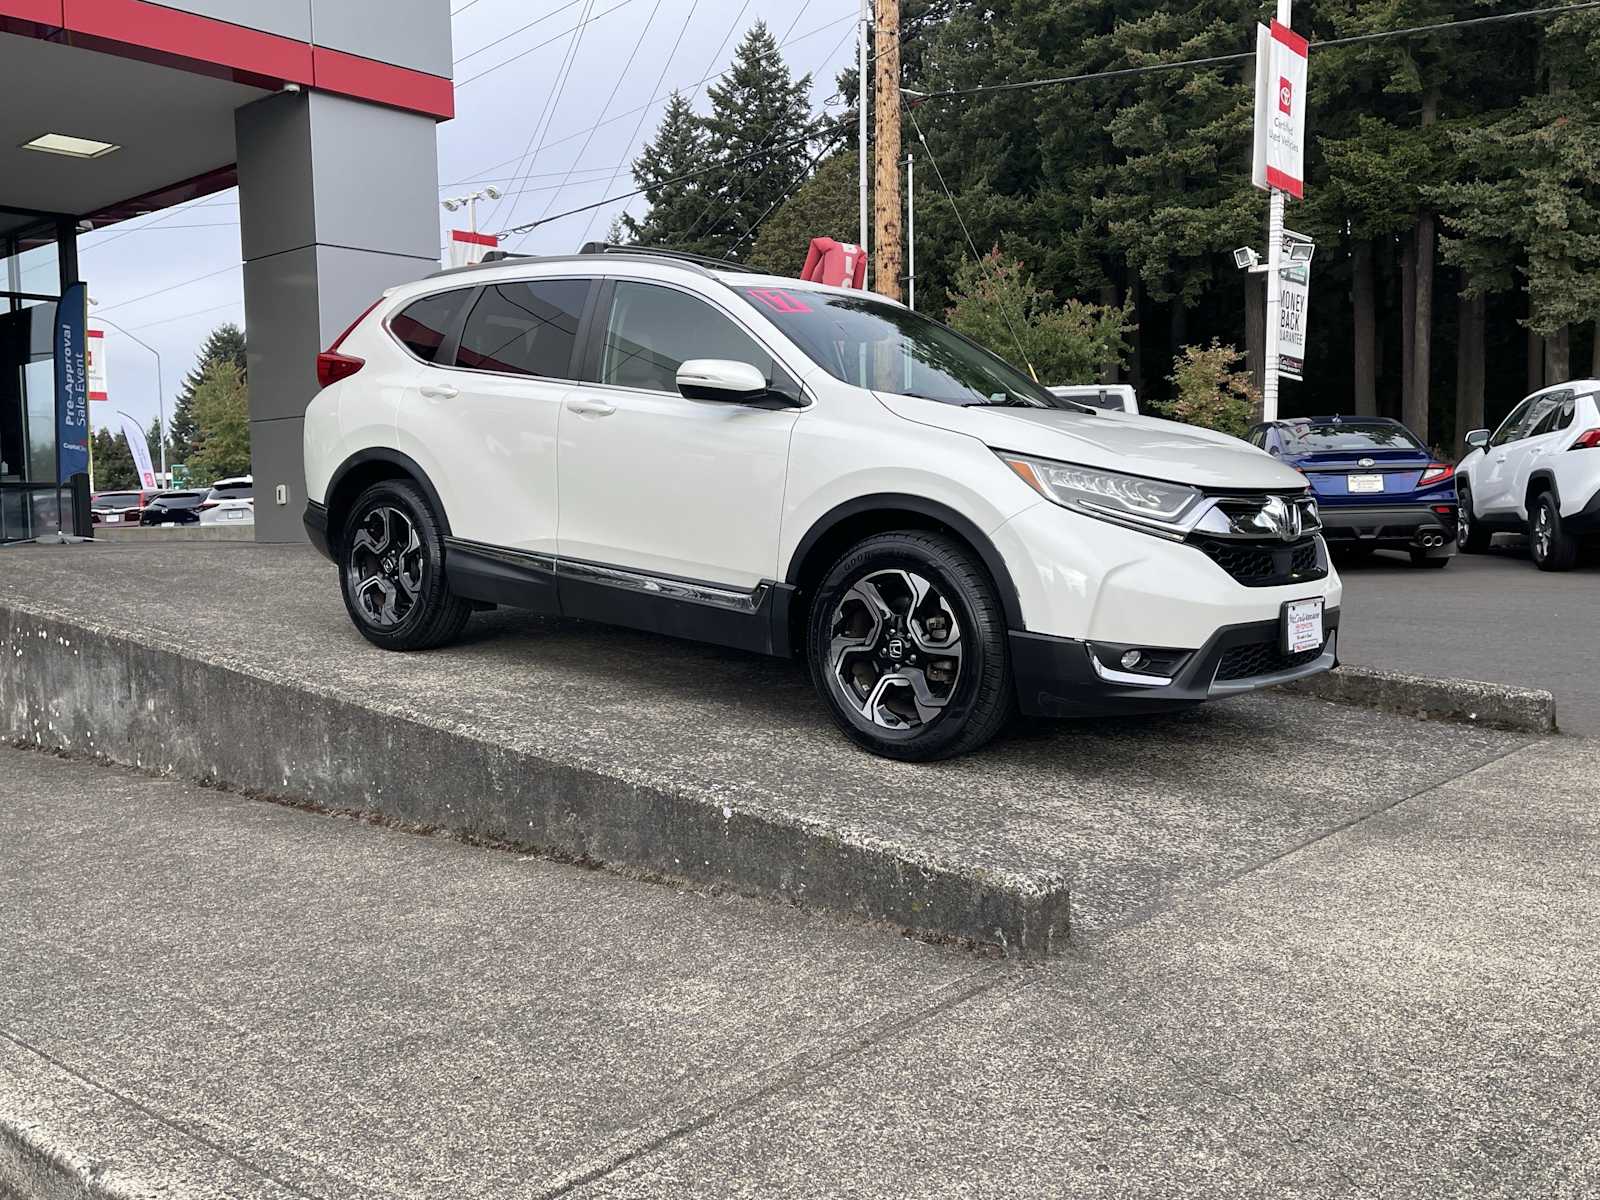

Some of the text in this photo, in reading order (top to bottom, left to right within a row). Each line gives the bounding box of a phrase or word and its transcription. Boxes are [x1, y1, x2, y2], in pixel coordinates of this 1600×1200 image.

[1280, 309, 1300, 332] BACK
[62, 324, 75, 426] Pre-Approval
[75, 352, 87, 427] Sale Event
